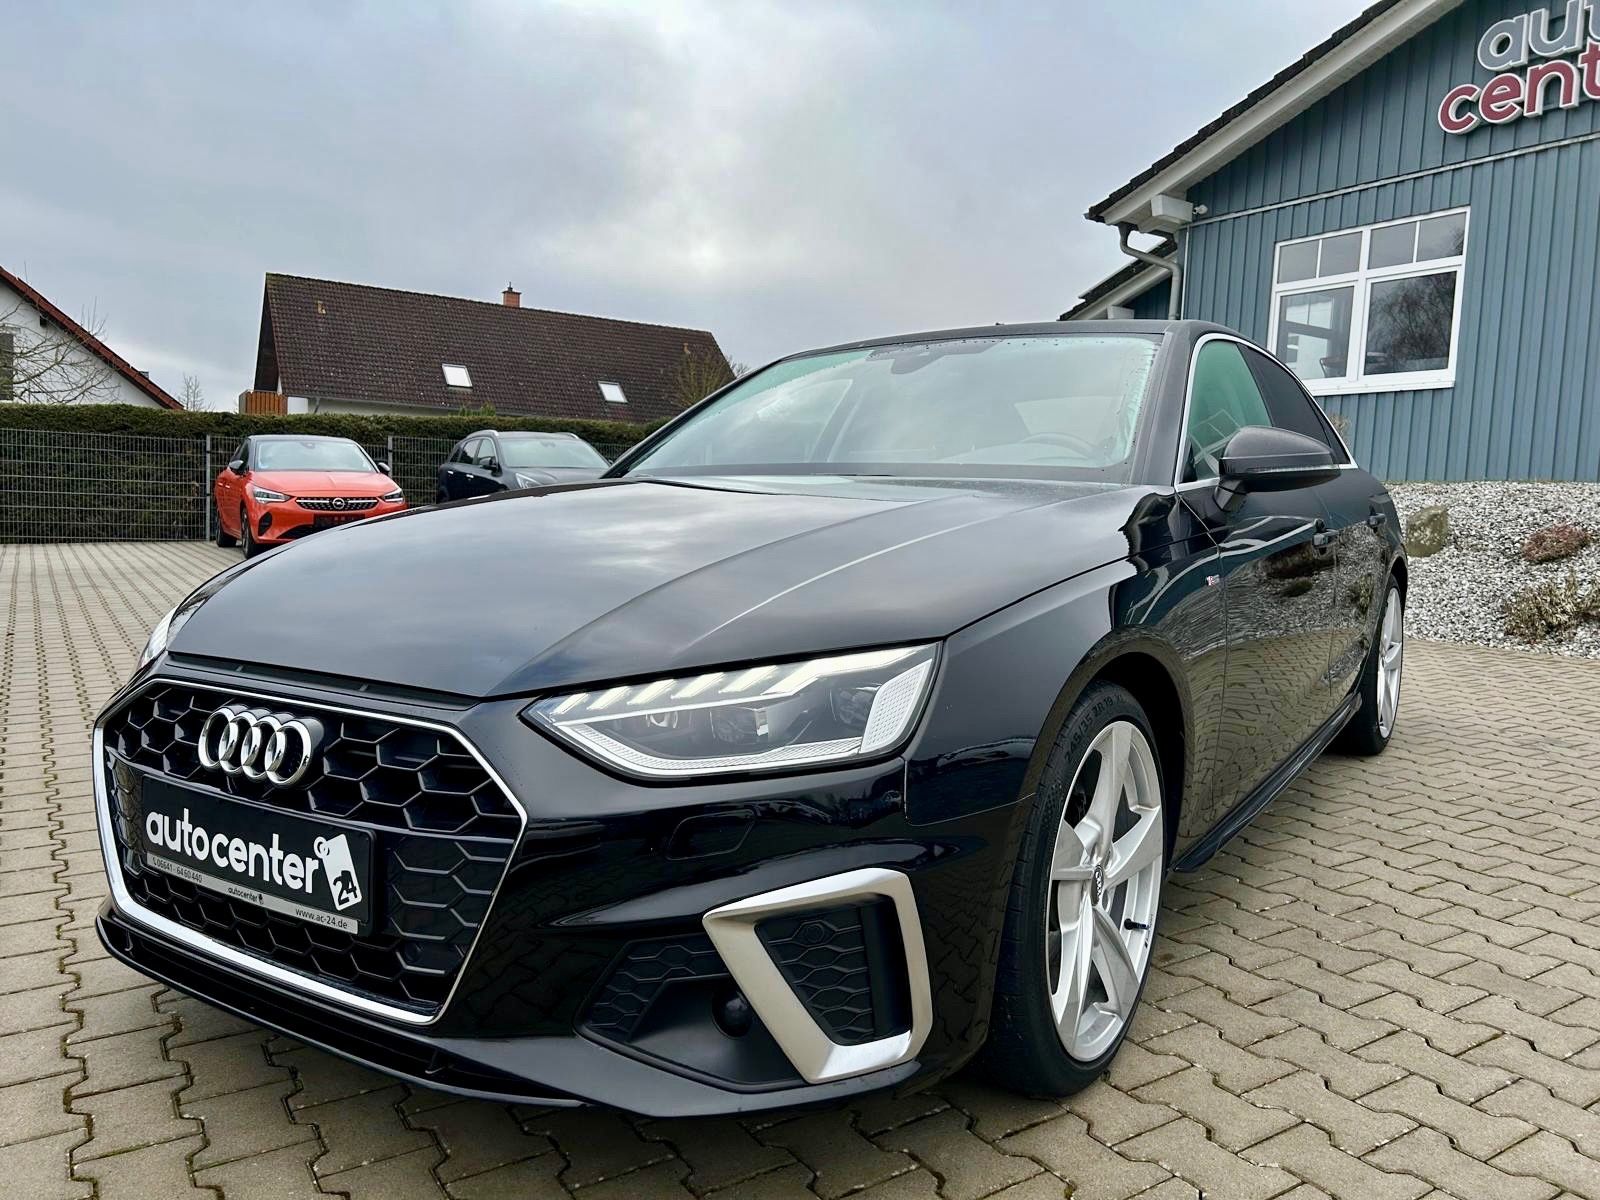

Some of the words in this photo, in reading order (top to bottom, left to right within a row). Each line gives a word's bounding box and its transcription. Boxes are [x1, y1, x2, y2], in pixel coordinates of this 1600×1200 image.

[145, 808, 319, 894] autocenter
[227, 886, 258, 902] autocenter
[333, 870, 358, 906] 24
[295, 908, 348, 929] www.ac-24.de
